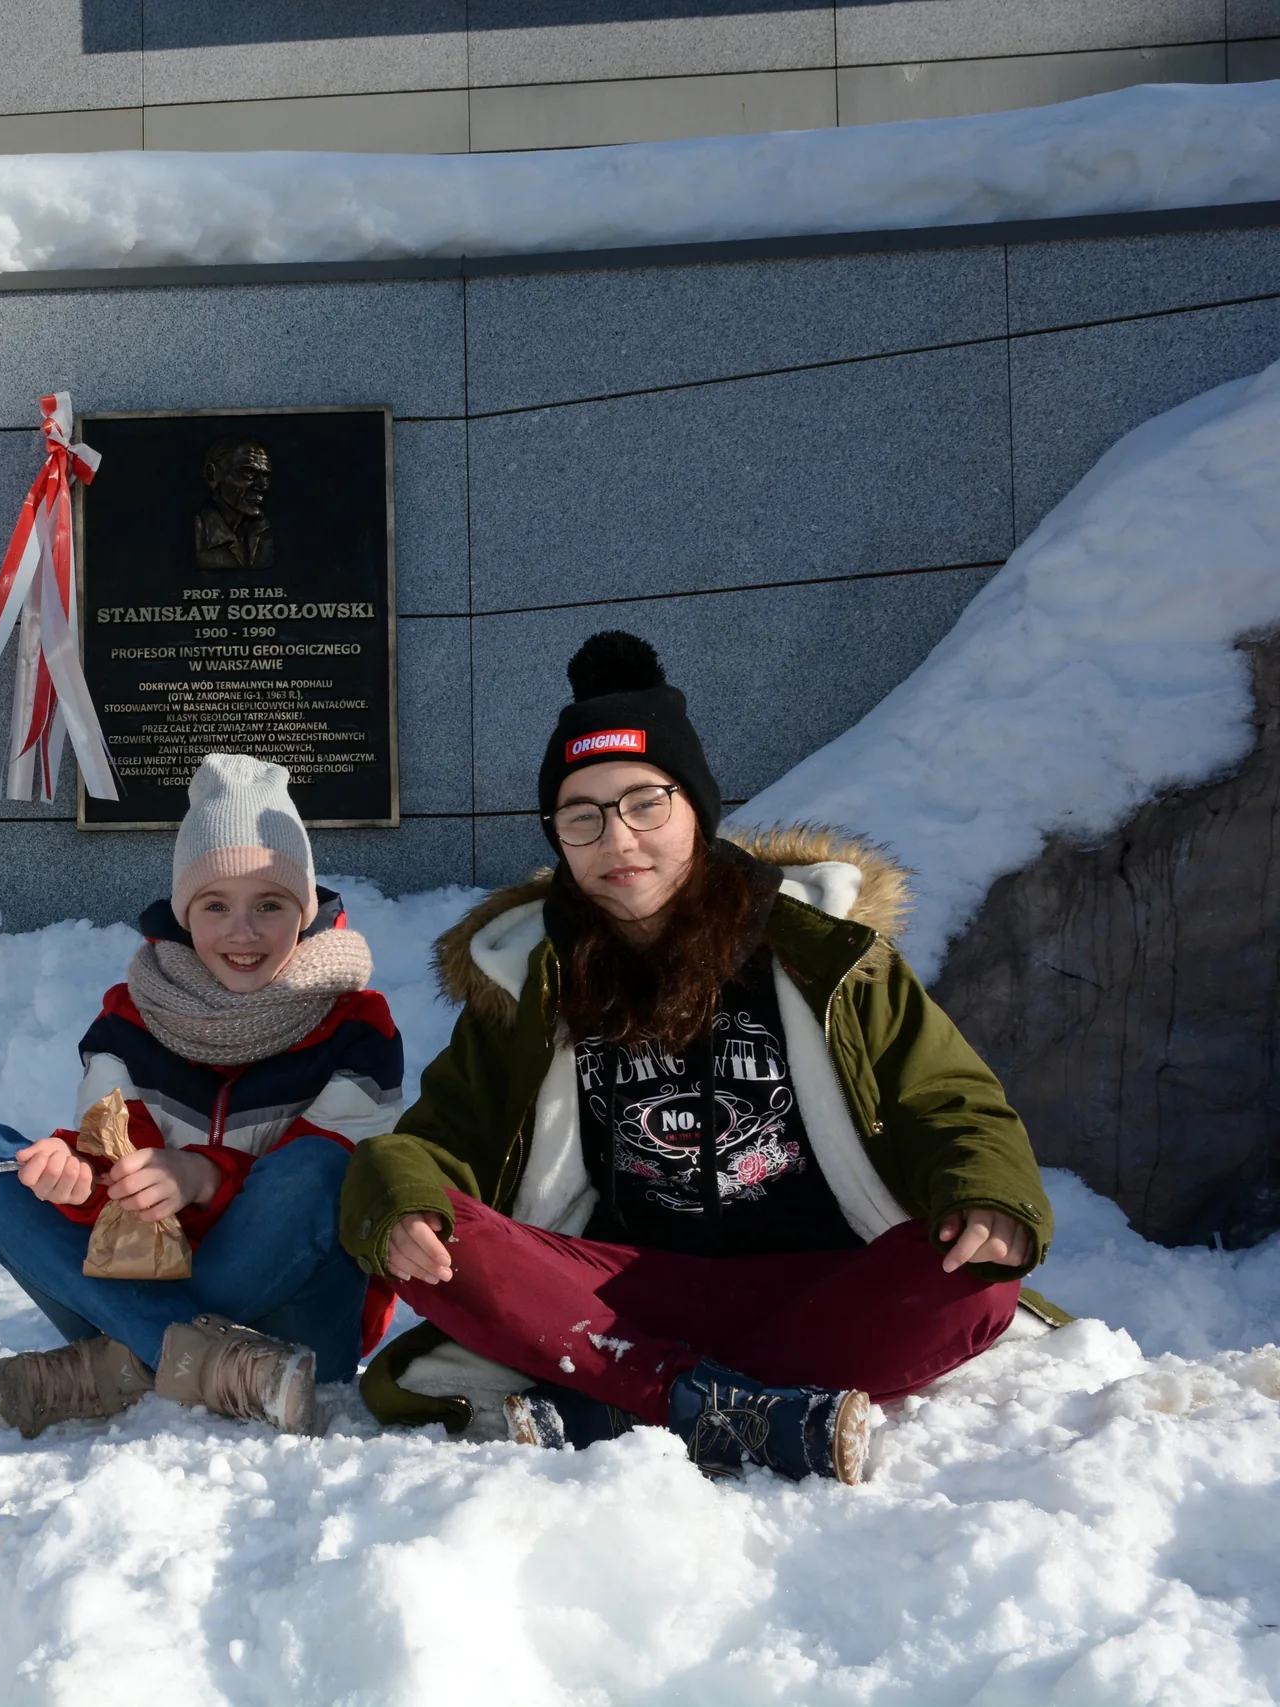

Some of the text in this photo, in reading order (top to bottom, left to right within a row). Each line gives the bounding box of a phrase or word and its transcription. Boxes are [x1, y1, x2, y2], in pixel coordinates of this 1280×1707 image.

[182, 587, 288, 600] PROF. DR HAB.
[97, 603, 375, 623] STANISŁAW SOKOŁOWSKI
[194, 627, 228, 639] 1900
[242, 626, 276, 638] 1990
[111, 643, 361, 659] PROFESOR INSTYTUTU GEOLOGICZNEGO
[188, 659, 284, 672] W WARSZAWIE
[138, 679, 333, 691] ODKRYWCA WÓD TERMALNYCH NA PODHALU
[168, 692, 194, 702] (OTW.
[196, 691, 241, 701] ZAKOPANE
[266, 690, 287, 700] 1963
[103, 699, 369, 713] STOSOWANYCH W BASENACH CIEPLICOWYCH NA ANTAŁÓWCE.
[166, 710, 305, 722] KLASYK GEOLOGII TATRZAŃSKIEJ.
[142, 721, 330, 734] PRZEZ CAŁE ŻYCIE ZWIĄZANY Z ZAKOPANEM.
[108, 732, 365, 745] CZŁOWIEK PRAWY, WYBITNY UCZONY O WSZECHSTRONNYCH
[572, 733, 638, 755] ORIGINAL
[158, 743, 315, 754] ZAINTERESOWANIACH NAUKOWYCH,
[144, 756, 177, 765] WIEDZY
[317, 752, 377, 762] BADAWCZYM.
[120, 765, 170, 776] ZASŁUŻONY
[172, 766, 190, 775] DLA
